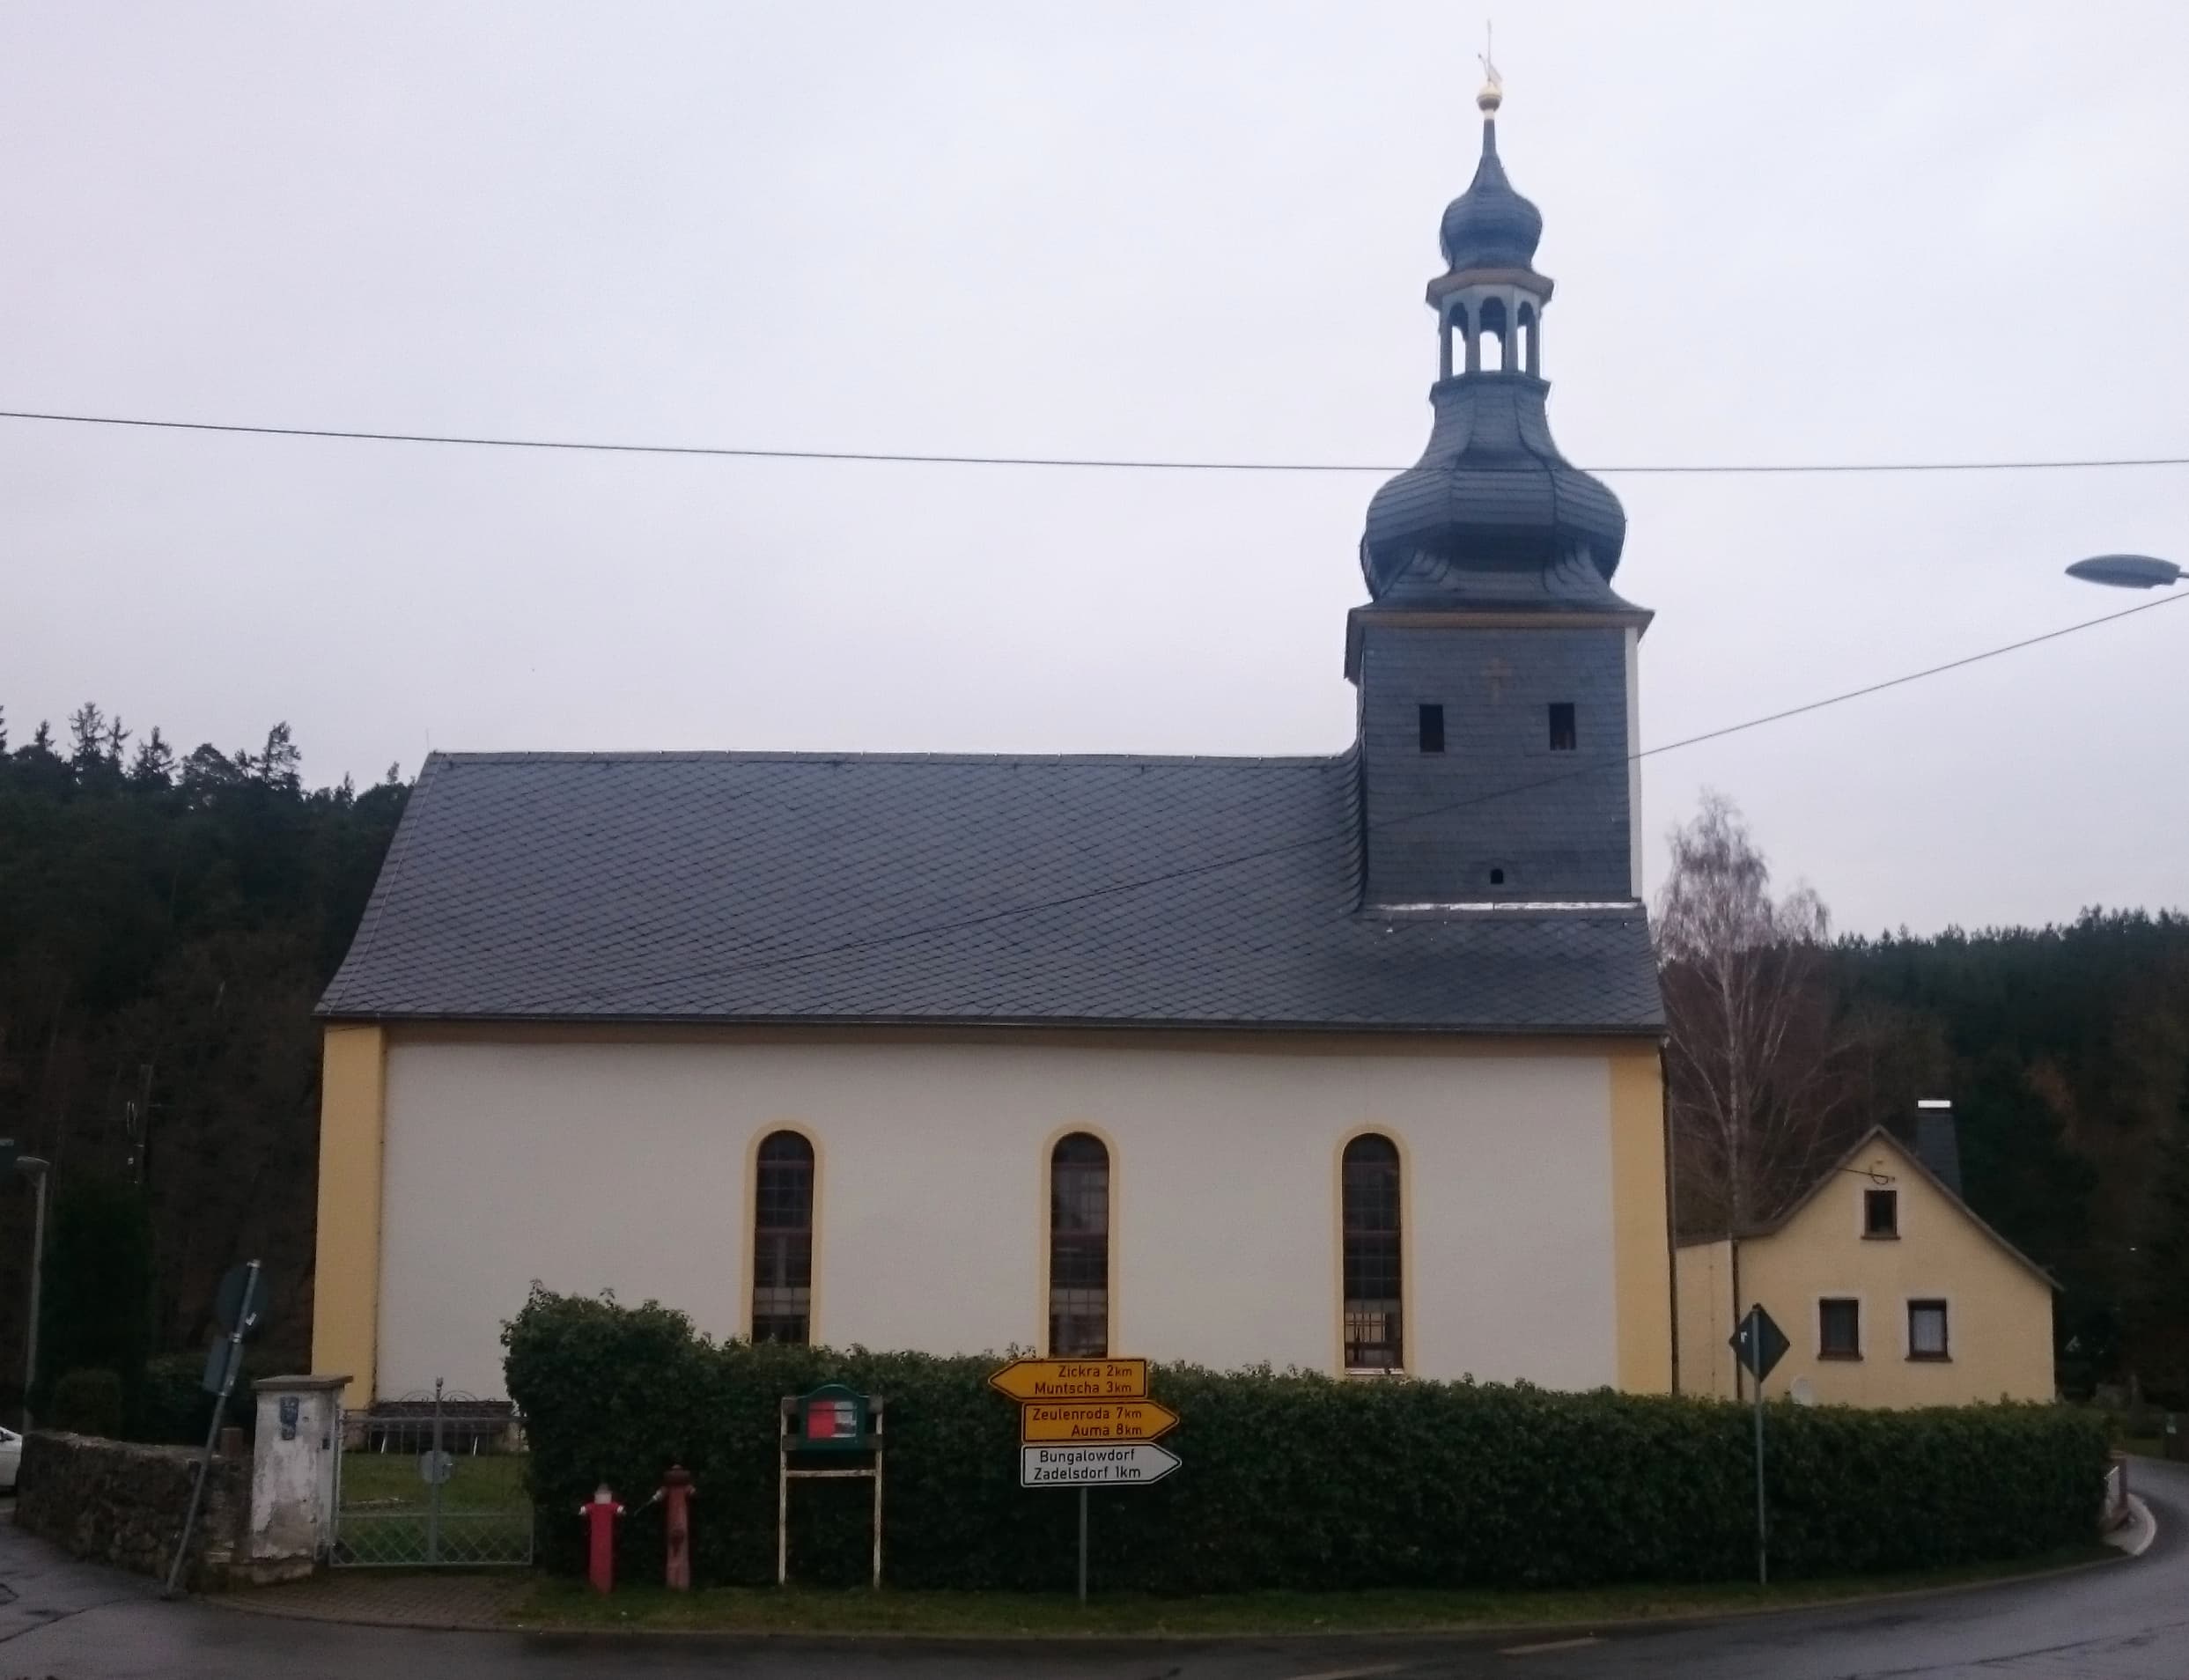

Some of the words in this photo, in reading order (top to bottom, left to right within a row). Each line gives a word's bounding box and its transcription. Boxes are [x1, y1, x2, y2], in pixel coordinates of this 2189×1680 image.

[1058, 1366, 1100, 1377] Zickra
[1036, 1382, 1099, 1395] Muntscha
[1033, 1407, 1109, 1420] Zeulenroda
[1072, 1425, 1109, 1436] Auma
[1040, 1448, 1135, 1463] Bungalowdorf
[1034, 1466, 1108, 1479] Zadelsdorf
